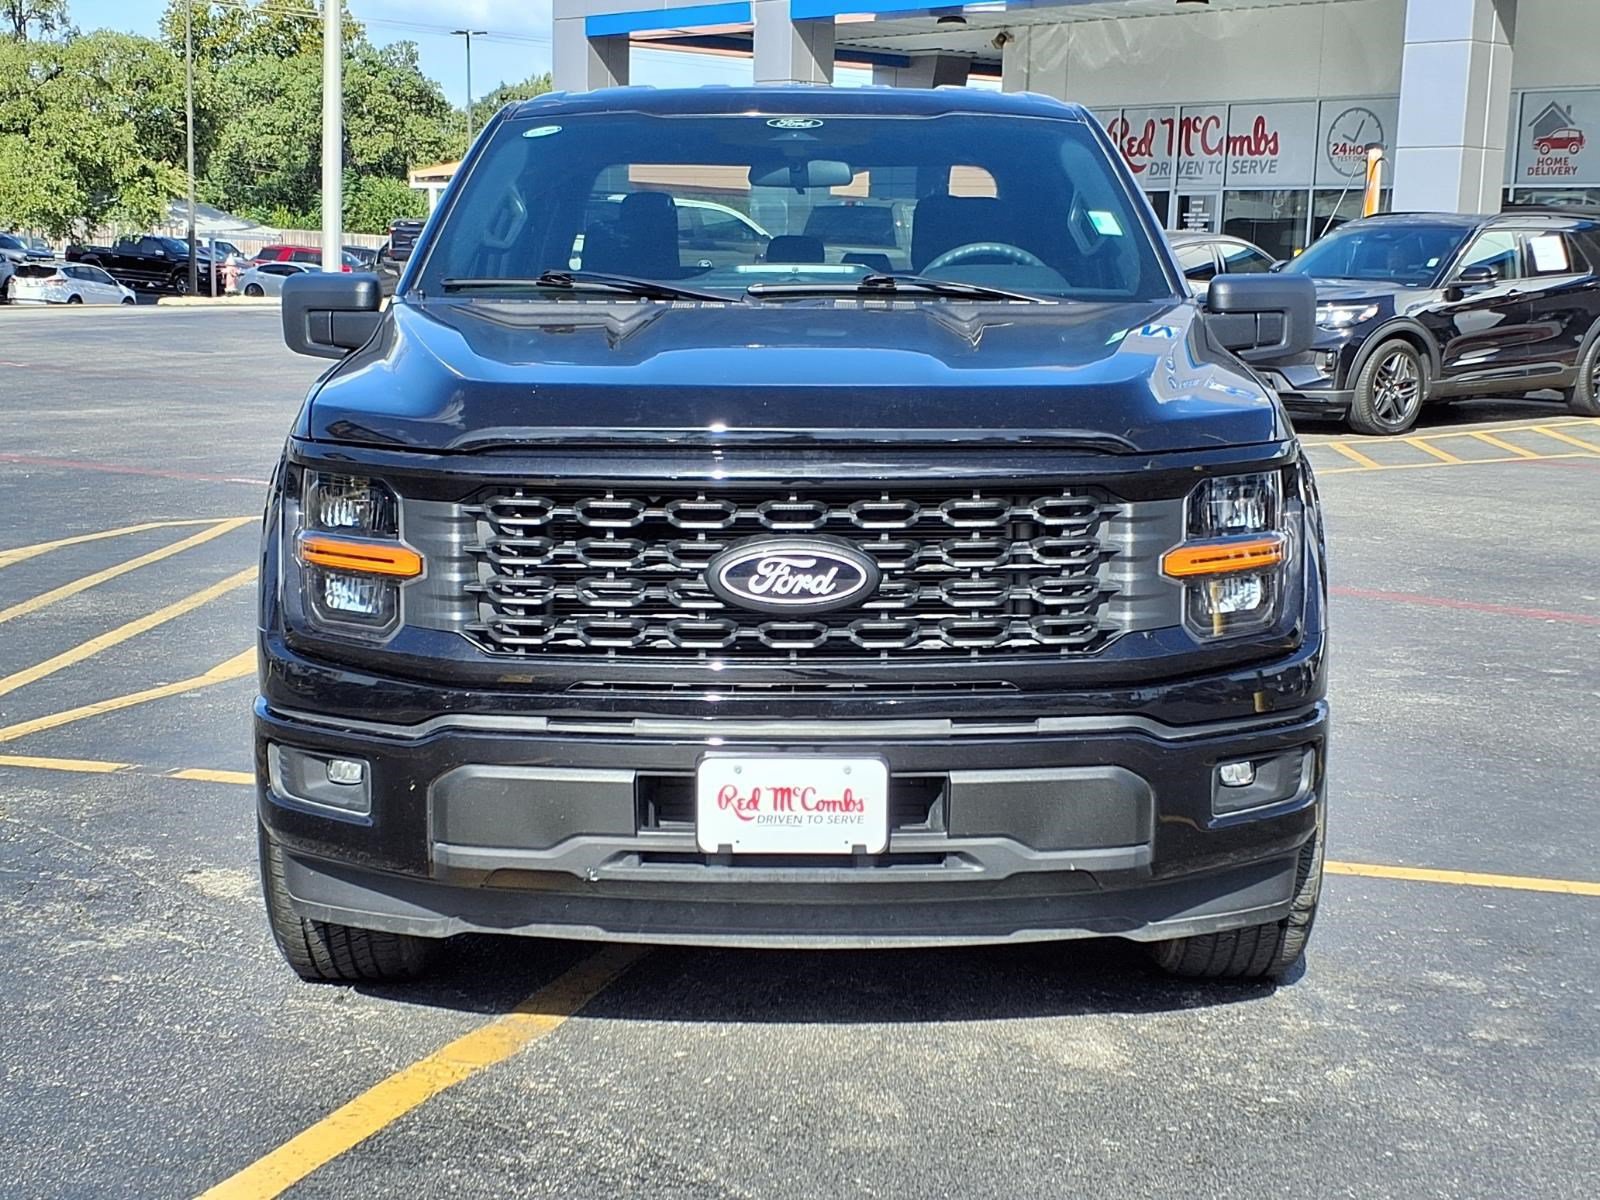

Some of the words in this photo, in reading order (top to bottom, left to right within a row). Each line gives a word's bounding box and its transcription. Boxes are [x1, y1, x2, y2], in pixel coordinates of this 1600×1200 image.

[1332, 142, 1348, 156] 24
[1149, 161, 1205, 176] DRIVEN
[1231, 159, 1278, 175] SERVE
[1536, 157, 1570, 166] HOME
[1527, 166, 1578, 176] DELIVERY
[748, 557, 838, 595] Ford
[717, 784, 761, 821] Red
[765, 786, 864, 813] McCombs
[757, 814, 803, 825] DRIVEN
[807, 814, 824, 825] TO
[827, 814, 865, 825] SERVE
